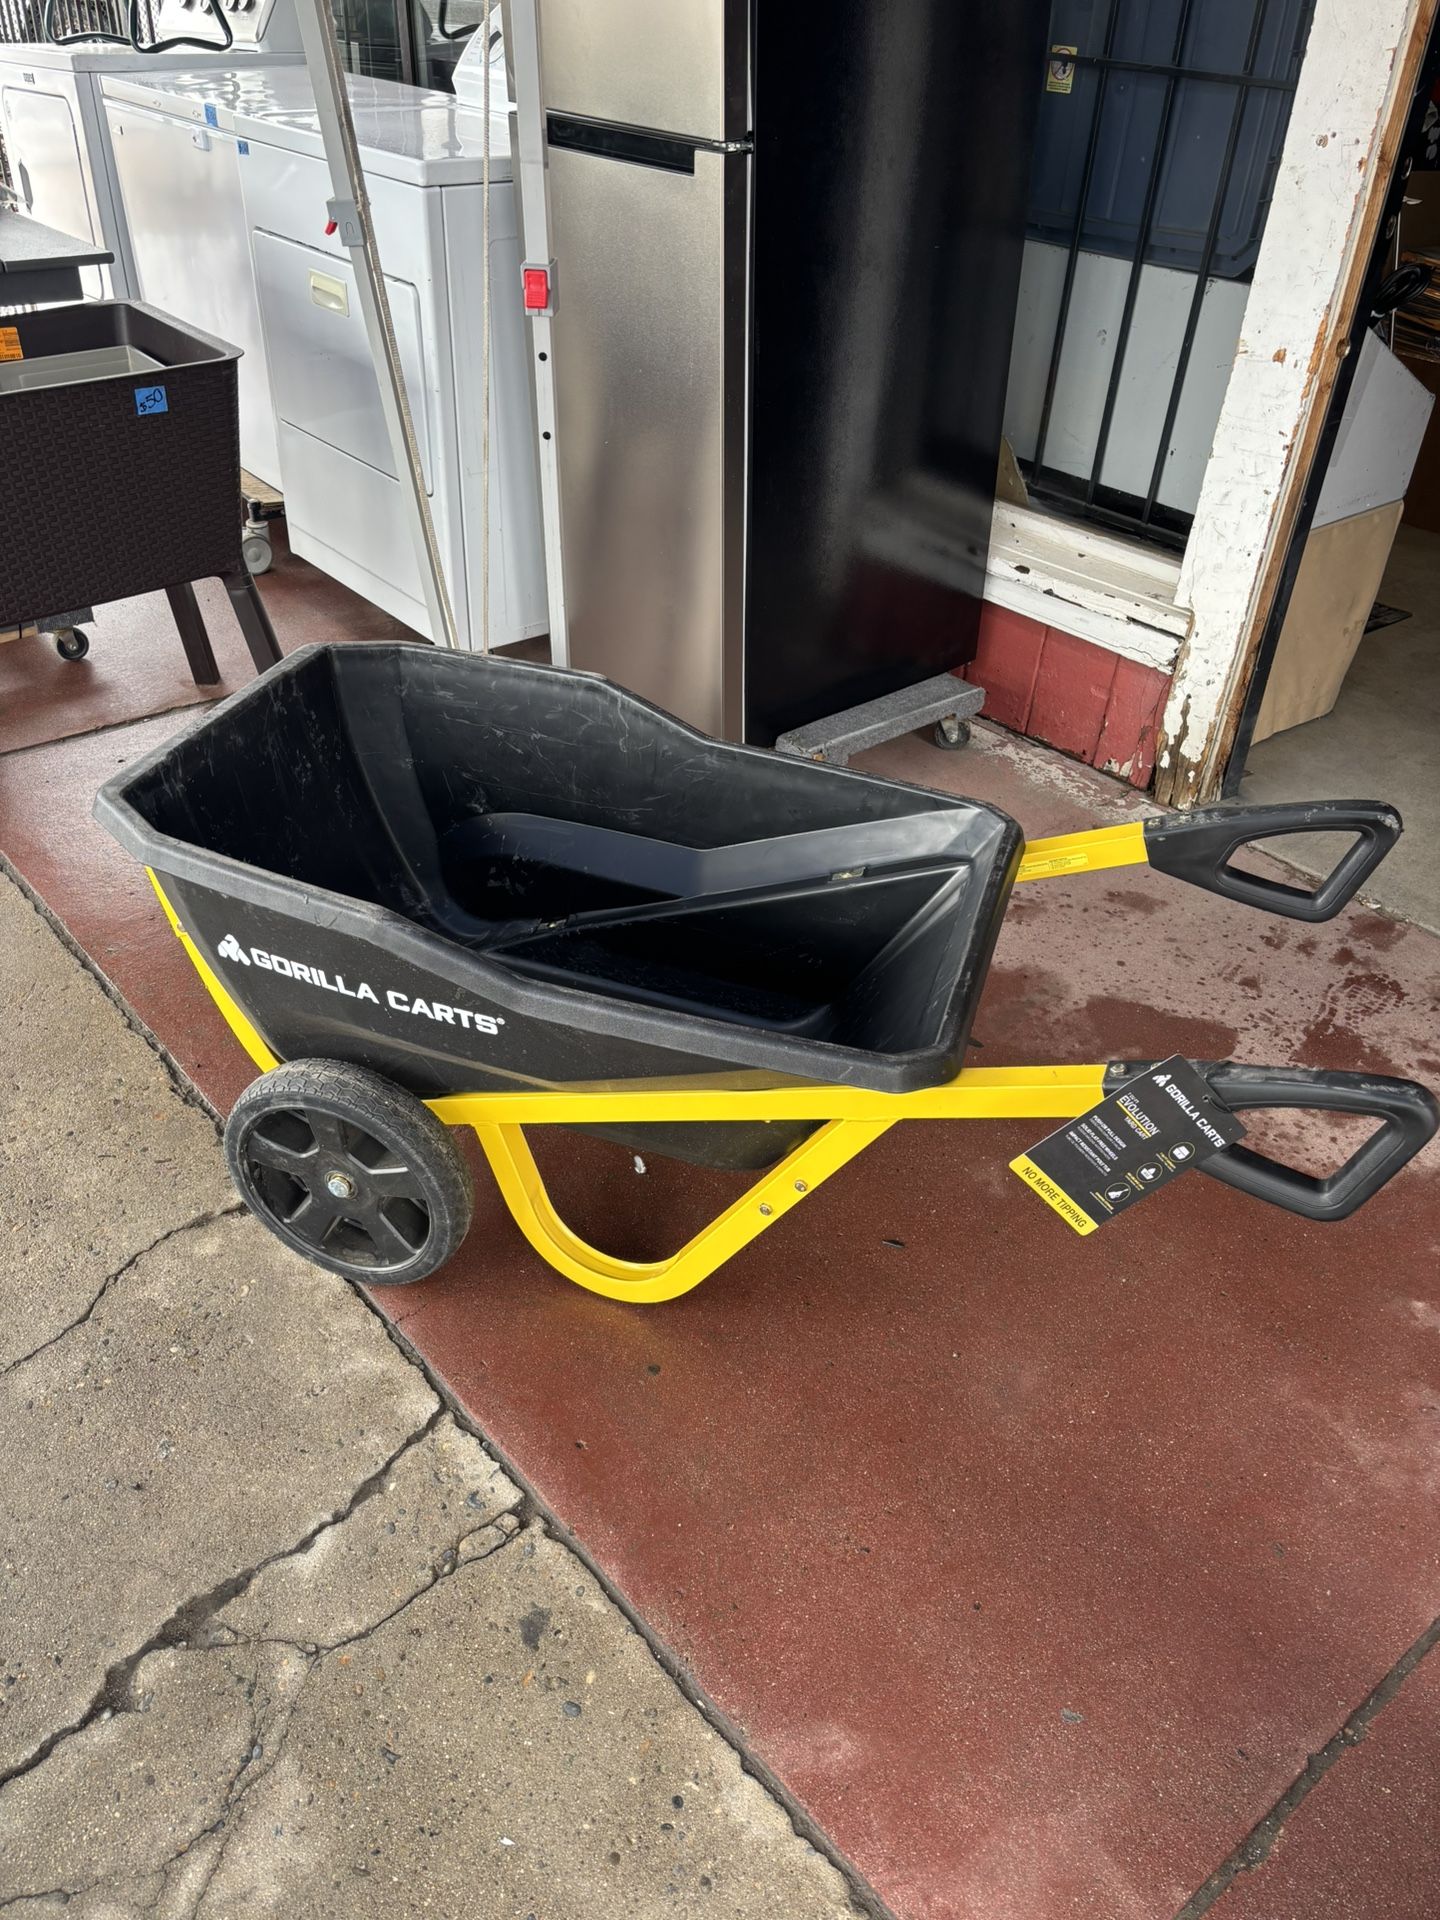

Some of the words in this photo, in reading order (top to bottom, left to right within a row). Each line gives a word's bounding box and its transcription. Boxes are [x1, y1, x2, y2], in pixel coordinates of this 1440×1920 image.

[139, 388, 163, 413] $50
[250, 947, 379, 1004] GORILLA
[1119, 1095, 1160, 1136] EVOLUTION
[1124, 1116, 1138, 1129] YARD
[1134, 1127, 1149, 1140] CART
[1165, 1083, 1200, 1121] GORILLA
[1196, 1118, 1226, 1148] CARTS
[1022, 1166, 1038, 1180] NO
[1034, 1178, 1060, 1201] MORE
[1056, 1198, 1087, 1228] TIPPING
